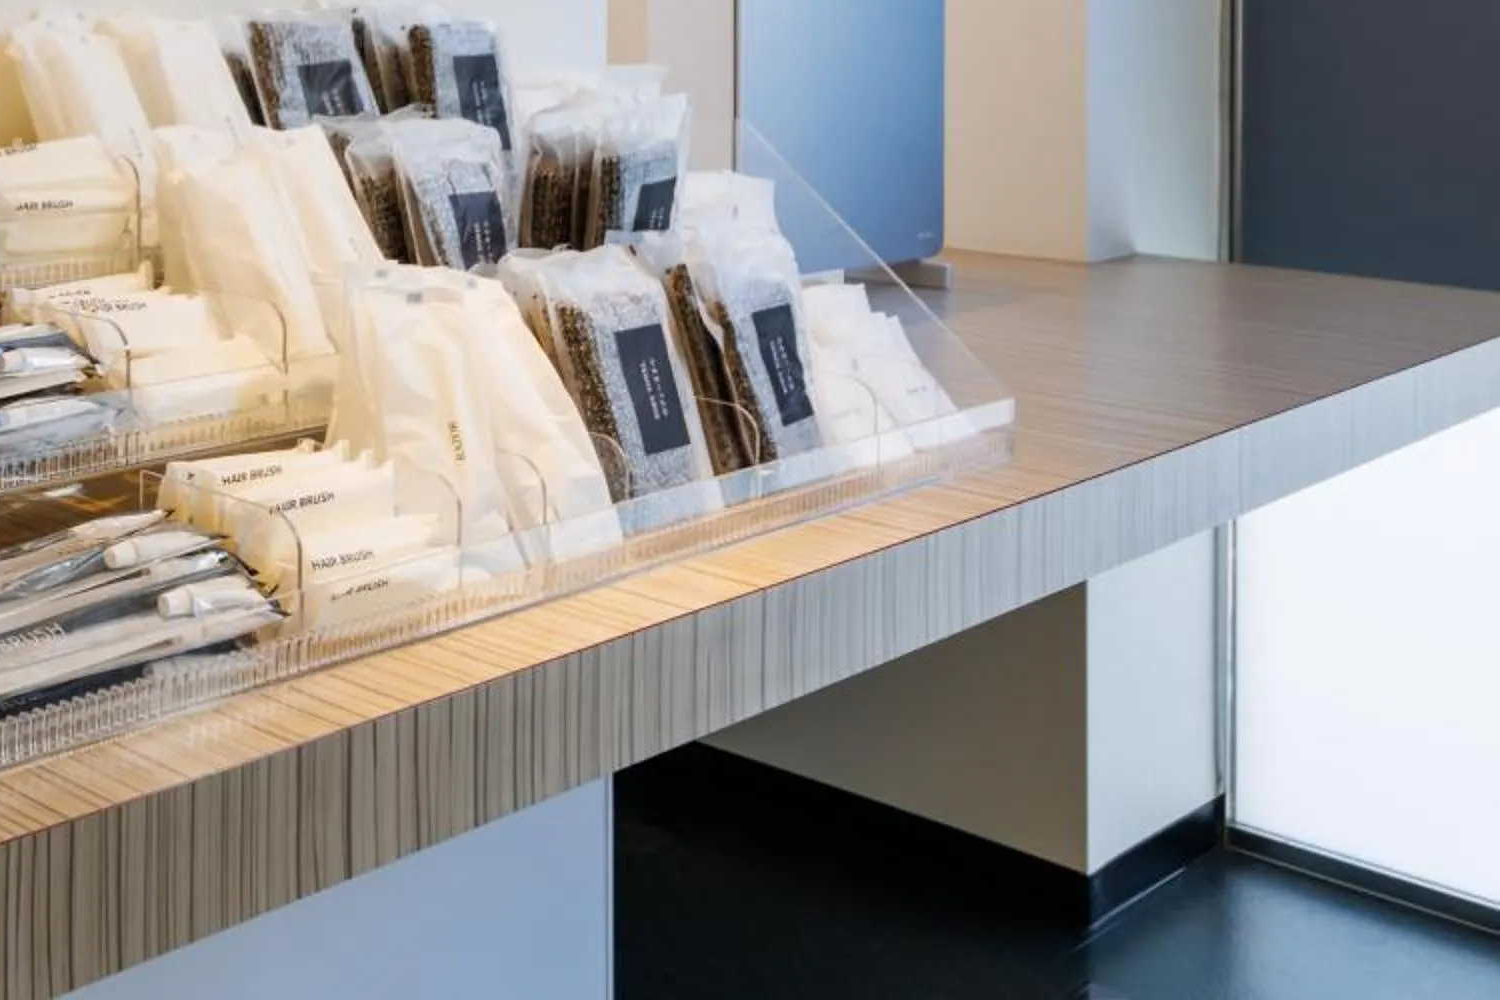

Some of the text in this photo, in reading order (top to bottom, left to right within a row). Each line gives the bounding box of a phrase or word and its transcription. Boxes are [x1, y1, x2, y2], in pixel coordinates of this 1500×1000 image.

[220, 465, 282, 485] HAIR BRUSH
[299, 491, 335, 508] BRUSH
[311, 550, 375, 571] HAIR BRUSH
